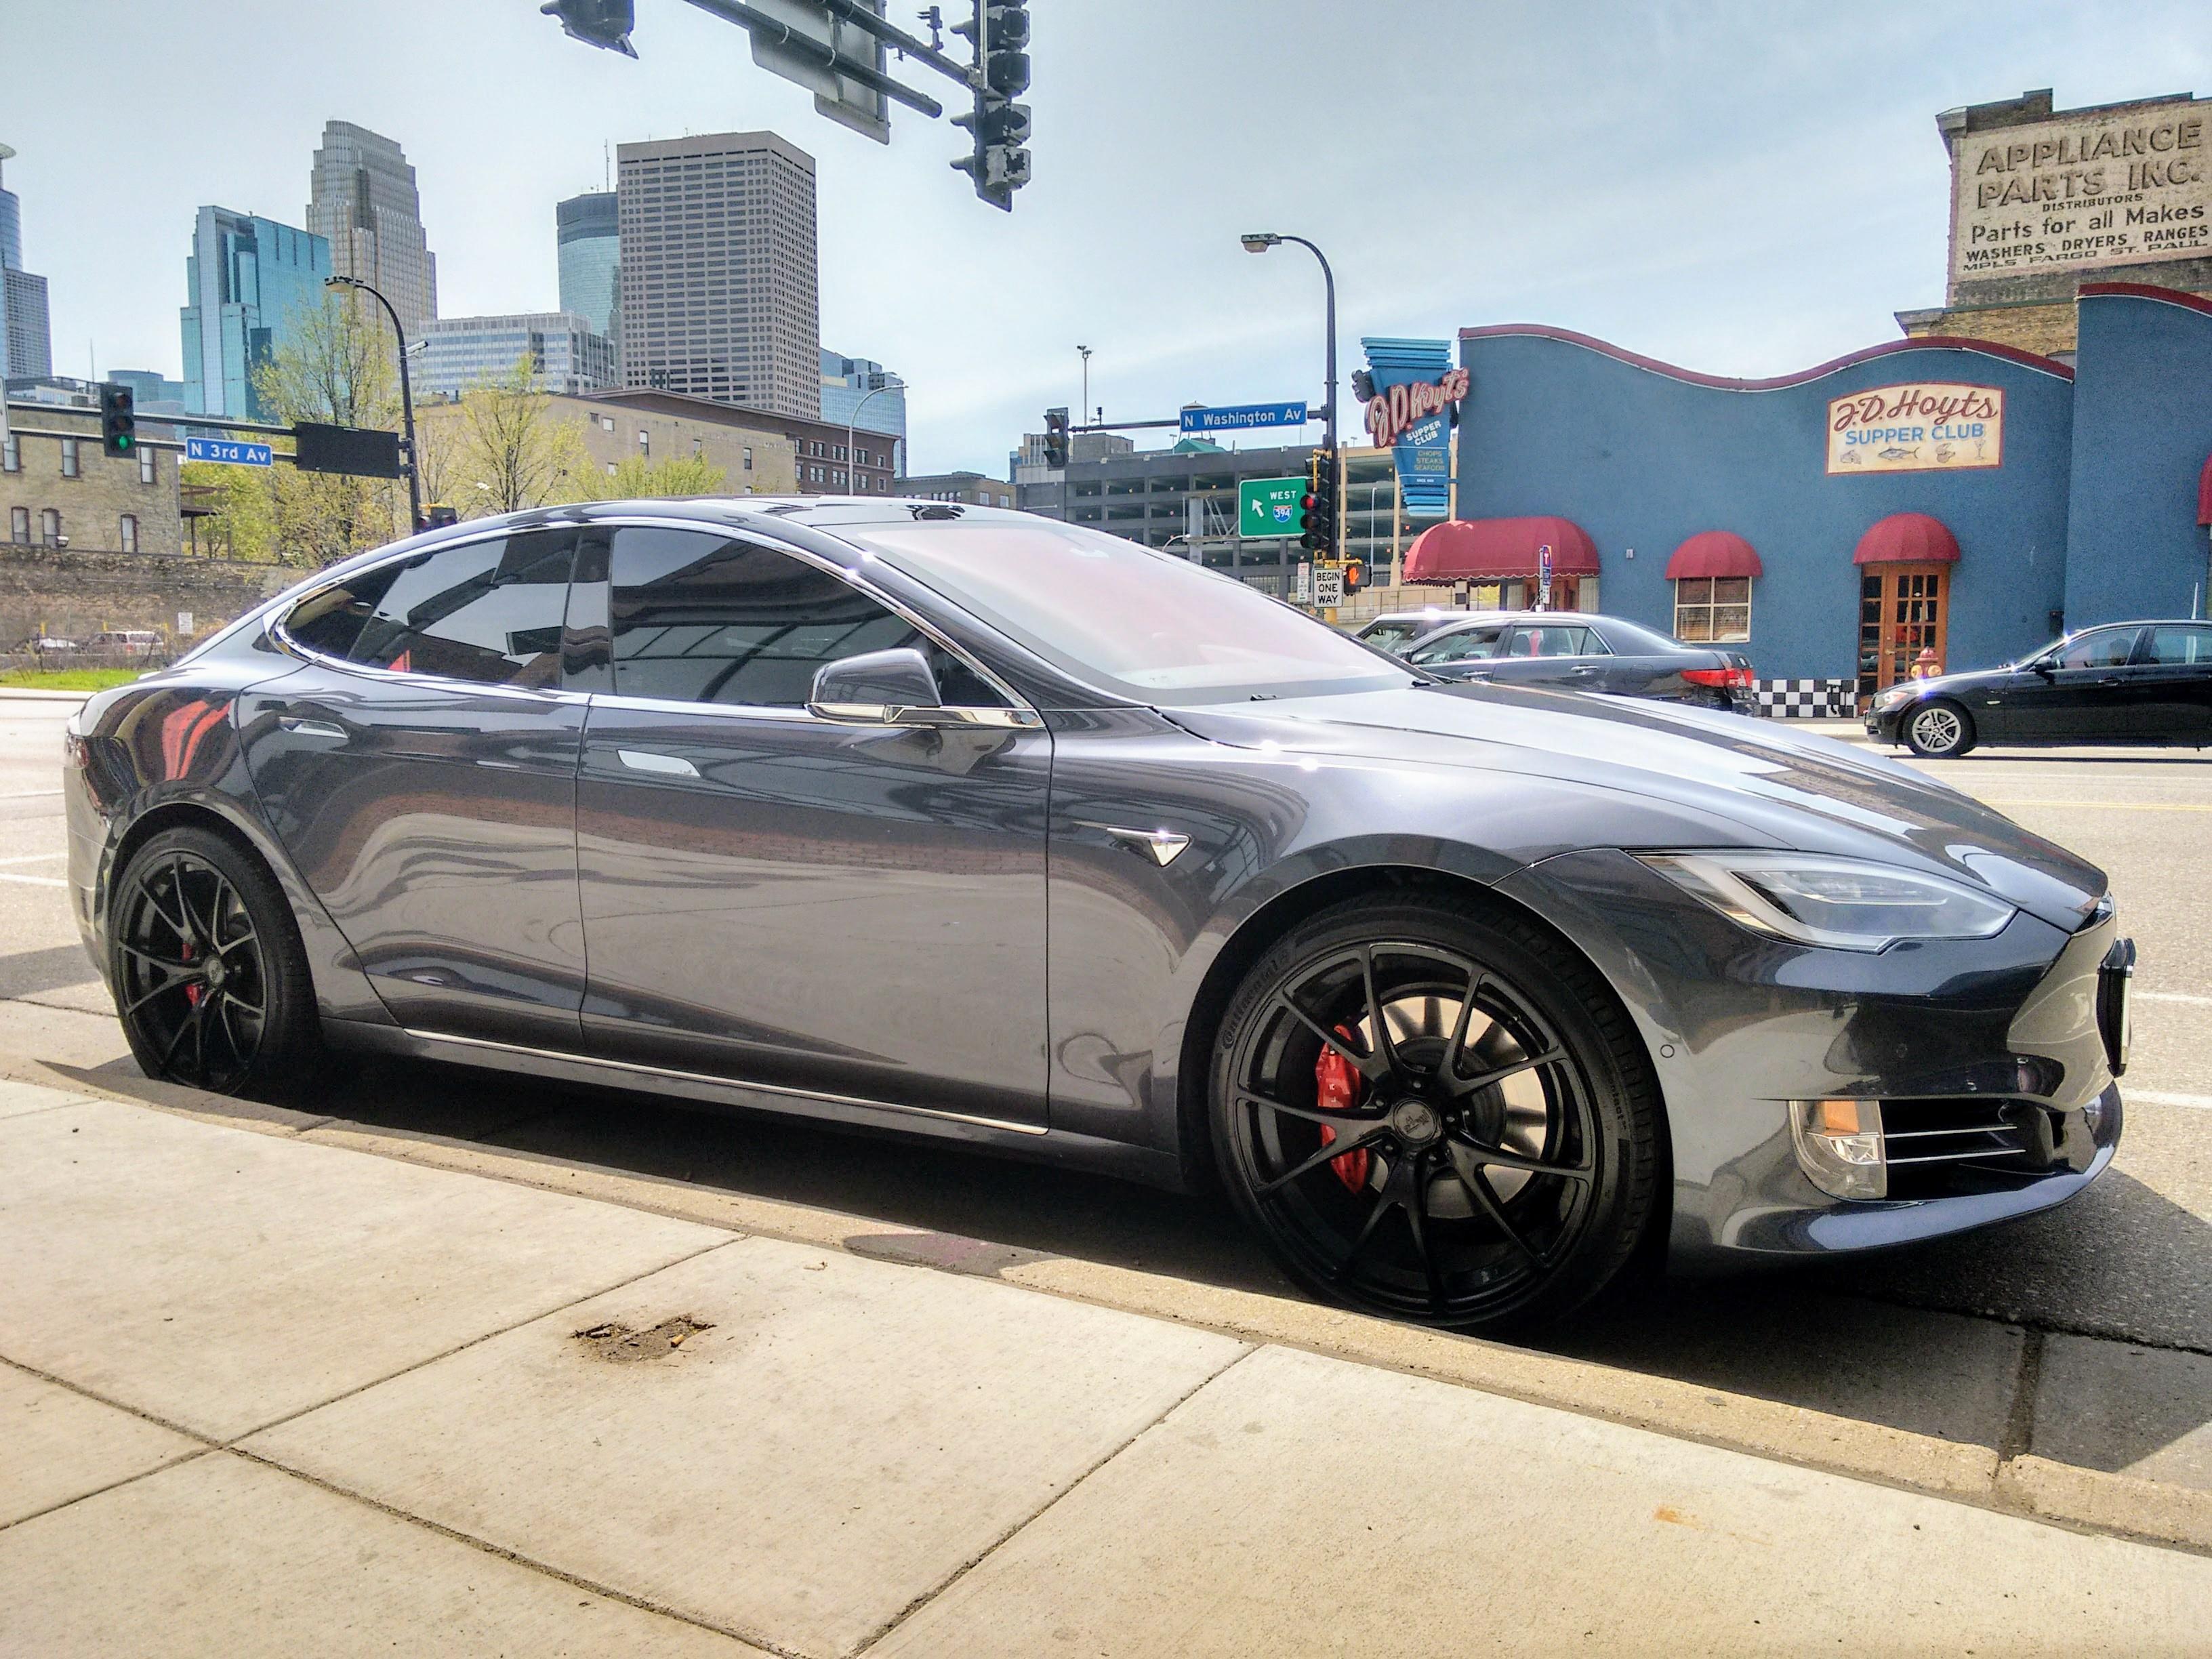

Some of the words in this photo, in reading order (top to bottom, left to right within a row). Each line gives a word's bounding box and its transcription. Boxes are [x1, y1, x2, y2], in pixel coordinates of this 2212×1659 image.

[1976, 119, 2202, 175] APPLIANCE
[1977, 169, 2106, 209] PARTS
[2128, 158, 2204, 191] INC.
[2043, 192, 2144, 213] DISTRIBUTORS
[1971, 220, 2032, 244] Parts
[2042, 216, 2076, 236] for
[2089, 210, 2113, 230] all
[2126, 203, 2205, 226] Makes
[1966, 242, 2045, 262] WASHERS
[2062, 233, 2127, 251] DRYERS
[2144, 224, 2208, 243] RANGES
[1963, 258, 2017, 271] MPLS
[2030, 250, 2097, 264] FARGO
[2147, 239, 2208, 253] PAUL
[1185, 415, 1193, 428] N
[1203, 411, 1275, 426] Washington
[1284, 408, 1301, 421] Av
[1406, 420, 1441, 441] SUPPER
[1414, 430, 1438, 446] CLUB
[1845, 426, 1923, 445] SUPPER
[1931, 422, 1984, 441] CLUB
[191, 442, 202, 456] N
[210, 444, 239, 459] 3rd
[246, 447, 267, 462] Av
[1270, 490, 1296, 500] WEST
[1274, 509, 1290, 518] 394
[1317, 572, 1340, 581] BEGIN
[1318, 583, 1338, 592] ONE
[1317, 595, 1338, 604] WAY
